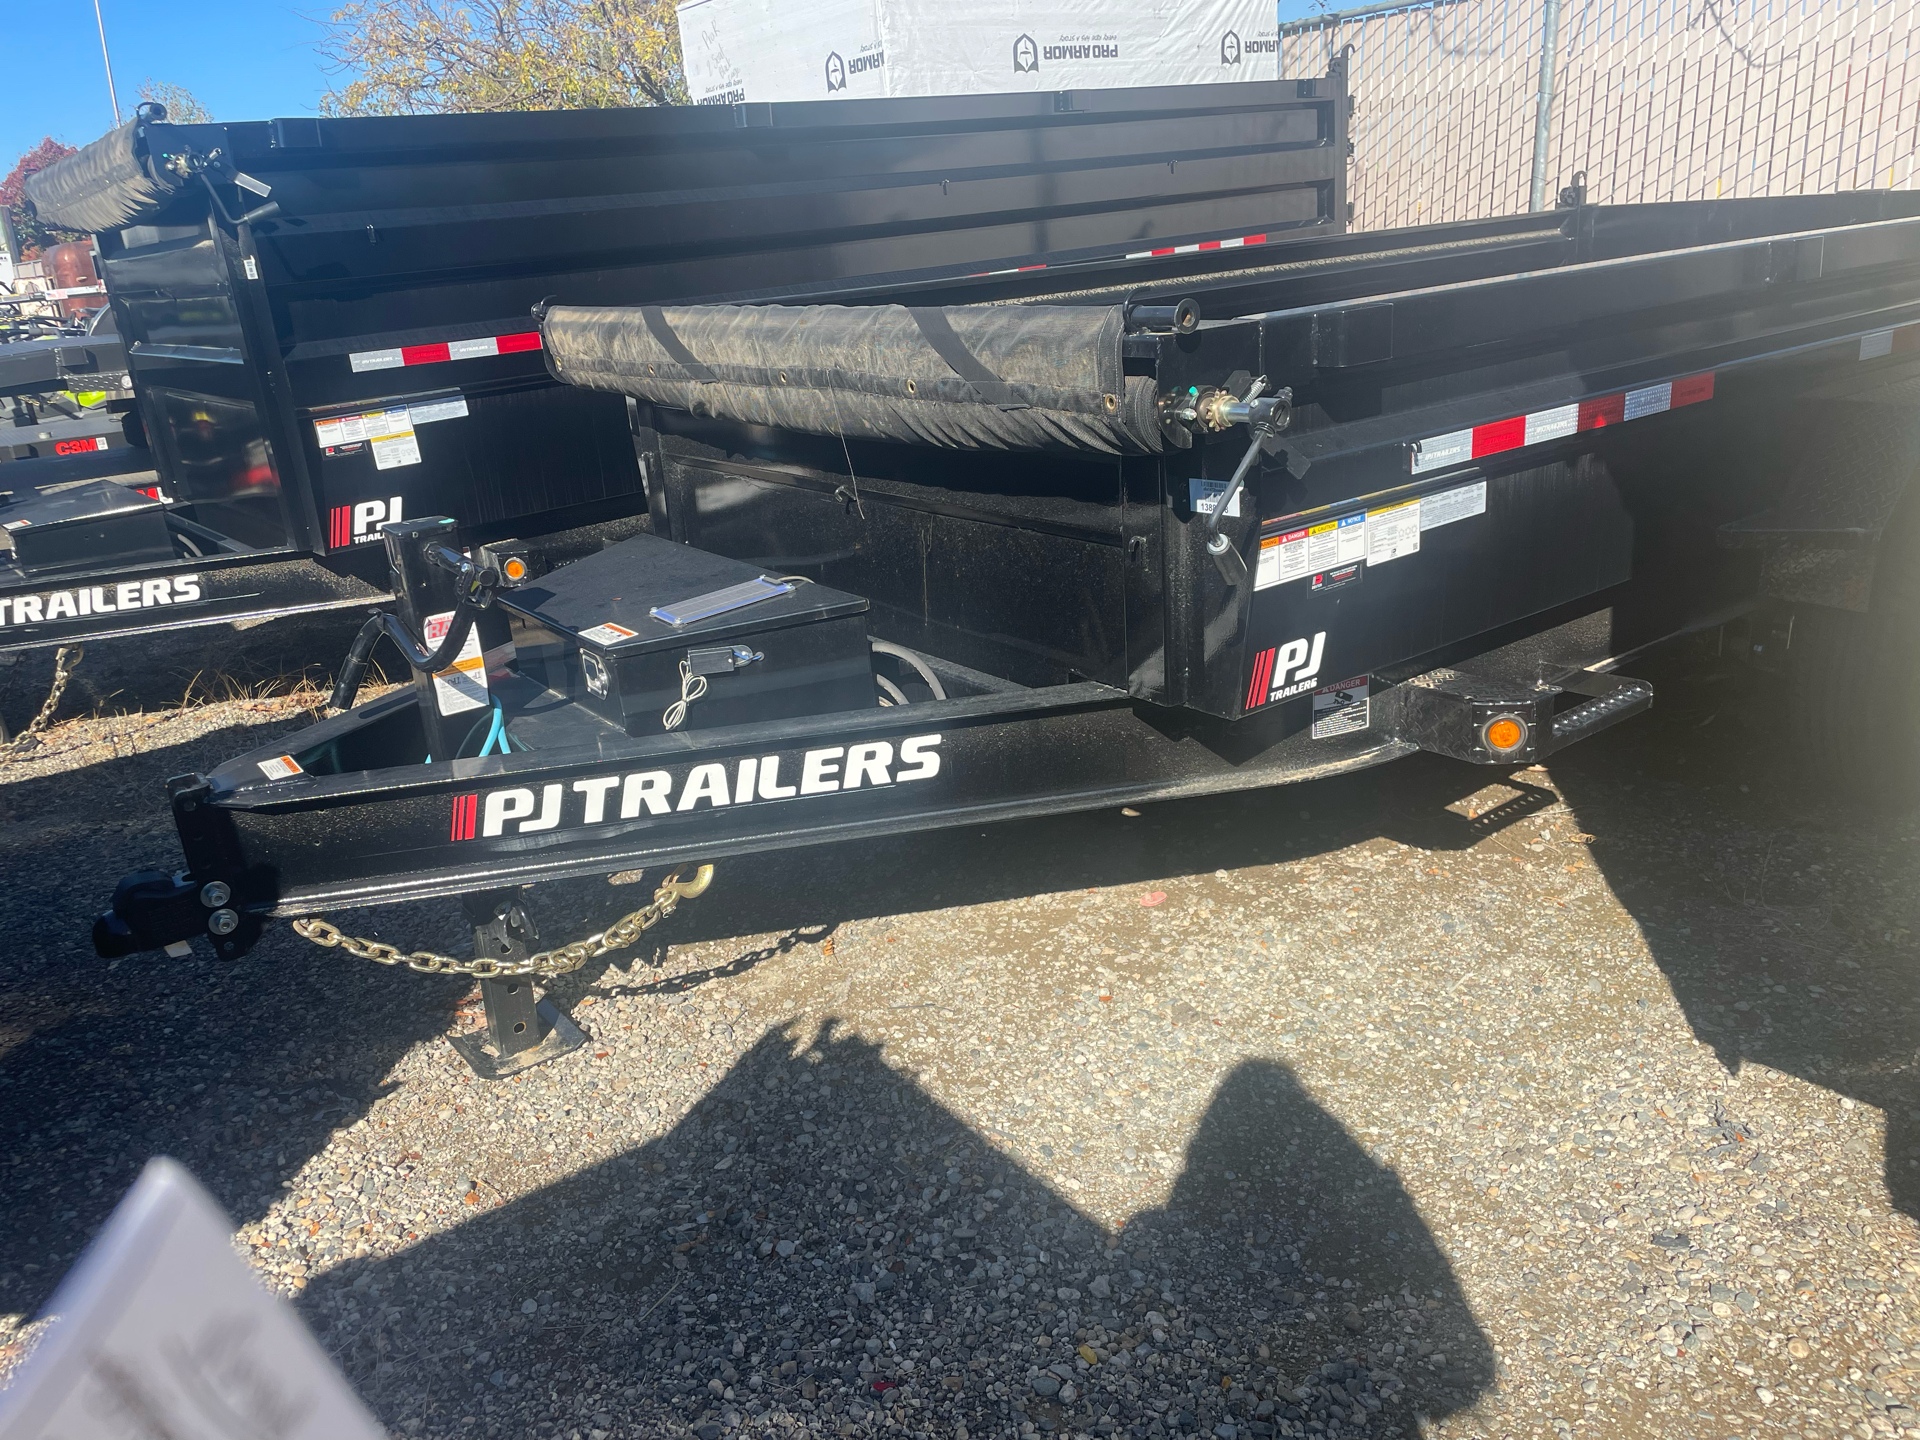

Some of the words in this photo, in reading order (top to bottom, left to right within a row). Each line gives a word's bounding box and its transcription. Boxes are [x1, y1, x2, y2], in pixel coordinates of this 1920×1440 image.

[55, 437, 98, 456] C3M
[354, 496, 402, 535] PJ
[1347, 515, 1362, 524] NOTICE
[1288, 531, 1306, 540] DANGER
[1317, 523, 1336, 533] CAUTION
[353, 532, 385, 544] TRAIL
[1272, 631, 1327, 689] PJ
[1270, 677, 1318, 702] TRAILERS
[1329, 679, 1361, 692] DANGER
[482, 784, 563, 838] PJ
[573, 733, 943, 824] TRAILERS
